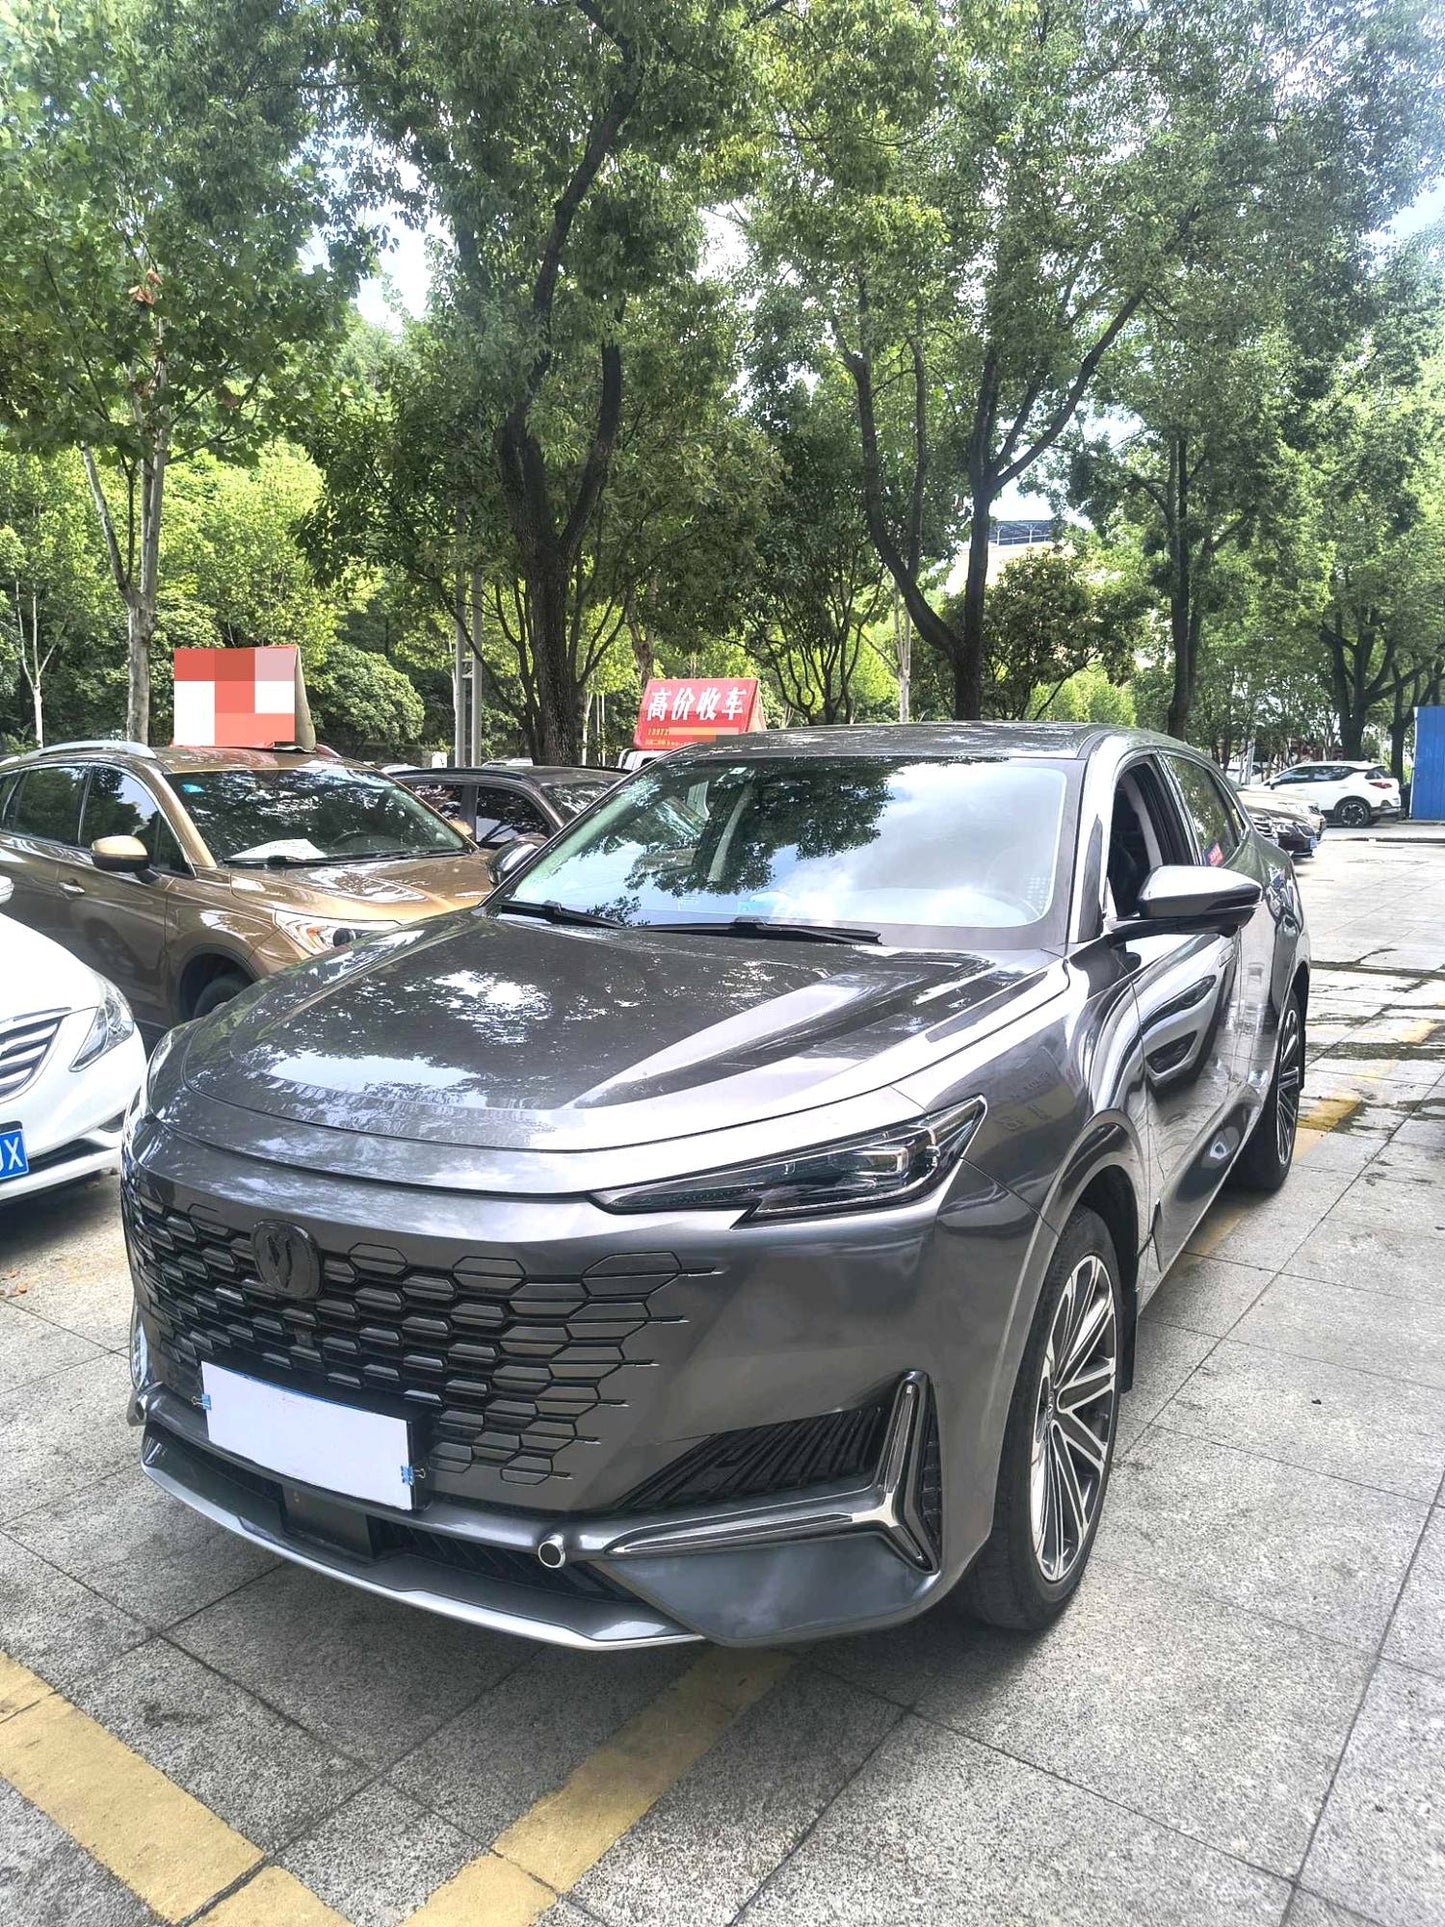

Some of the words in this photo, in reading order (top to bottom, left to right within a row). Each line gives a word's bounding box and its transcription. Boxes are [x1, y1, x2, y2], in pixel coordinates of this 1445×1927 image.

[647, 687, 747, 721] 高价收车
[0, 1137, 24, 1172] X
